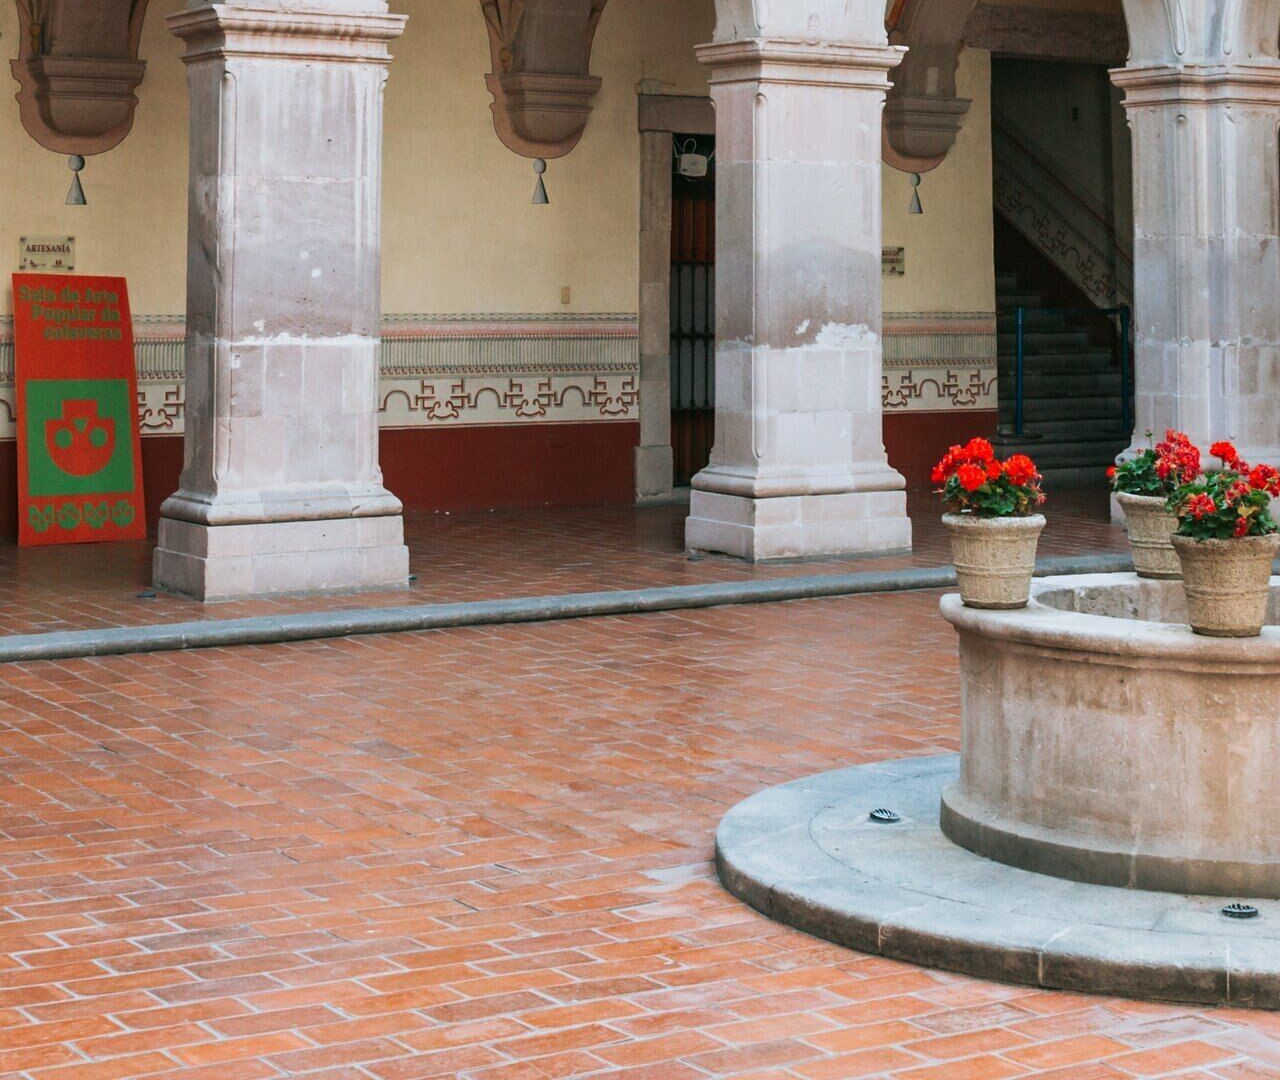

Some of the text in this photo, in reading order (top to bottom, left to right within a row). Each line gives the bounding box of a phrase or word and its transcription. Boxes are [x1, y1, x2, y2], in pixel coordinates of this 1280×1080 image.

[19, 286, 118, 303] Sala de Arte
[31, 304, 120, 324] Popular de
